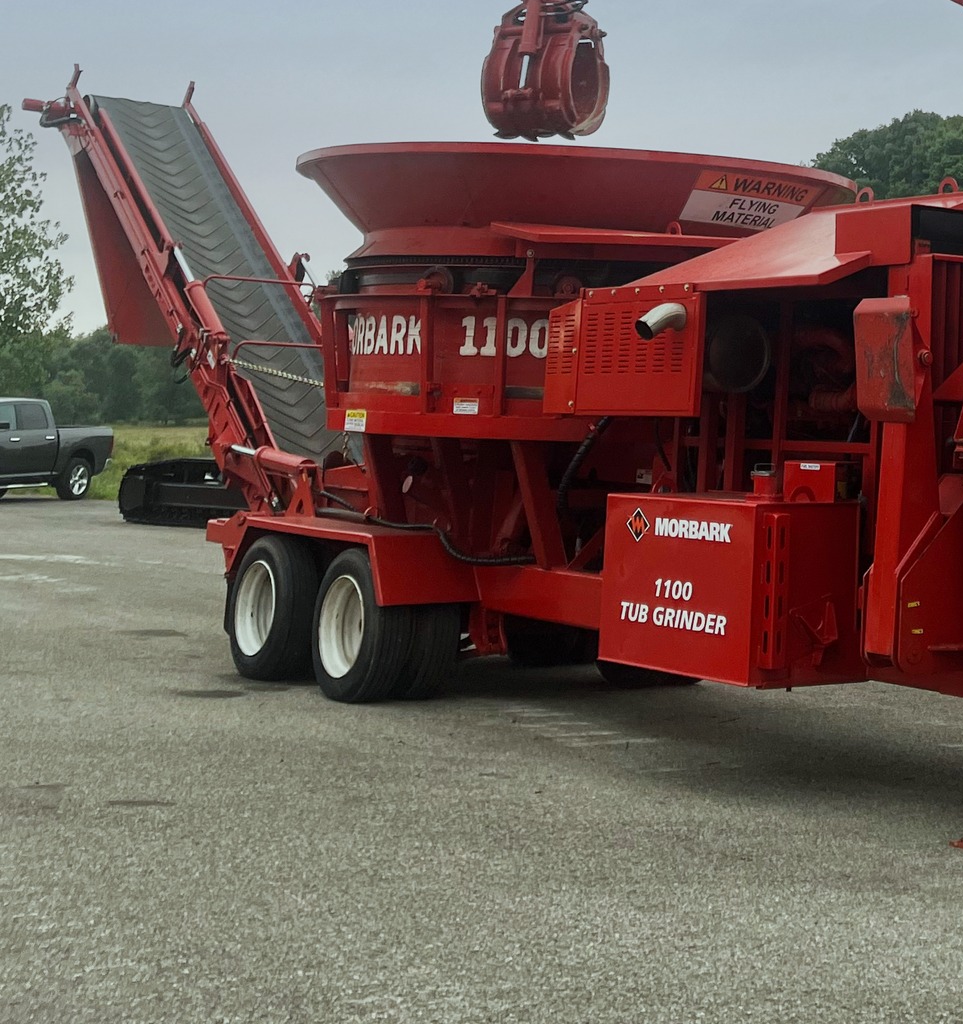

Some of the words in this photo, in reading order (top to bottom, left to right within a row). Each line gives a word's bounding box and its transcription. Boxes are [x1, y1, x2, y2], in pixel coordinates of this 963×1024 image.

[733, 177, 809, 202] WARNING
[728, 198, 779, 215] FLYING
[711, 210, 776, 229] MATERIAL
[459, 316, 549, 358] 1100
[654, 517, 732, 543] MORBARK
[655, 578, 693, 601] 1100
[620, 601, 649, 623] TUB
[652, 606, 727, 636] GRINDER
